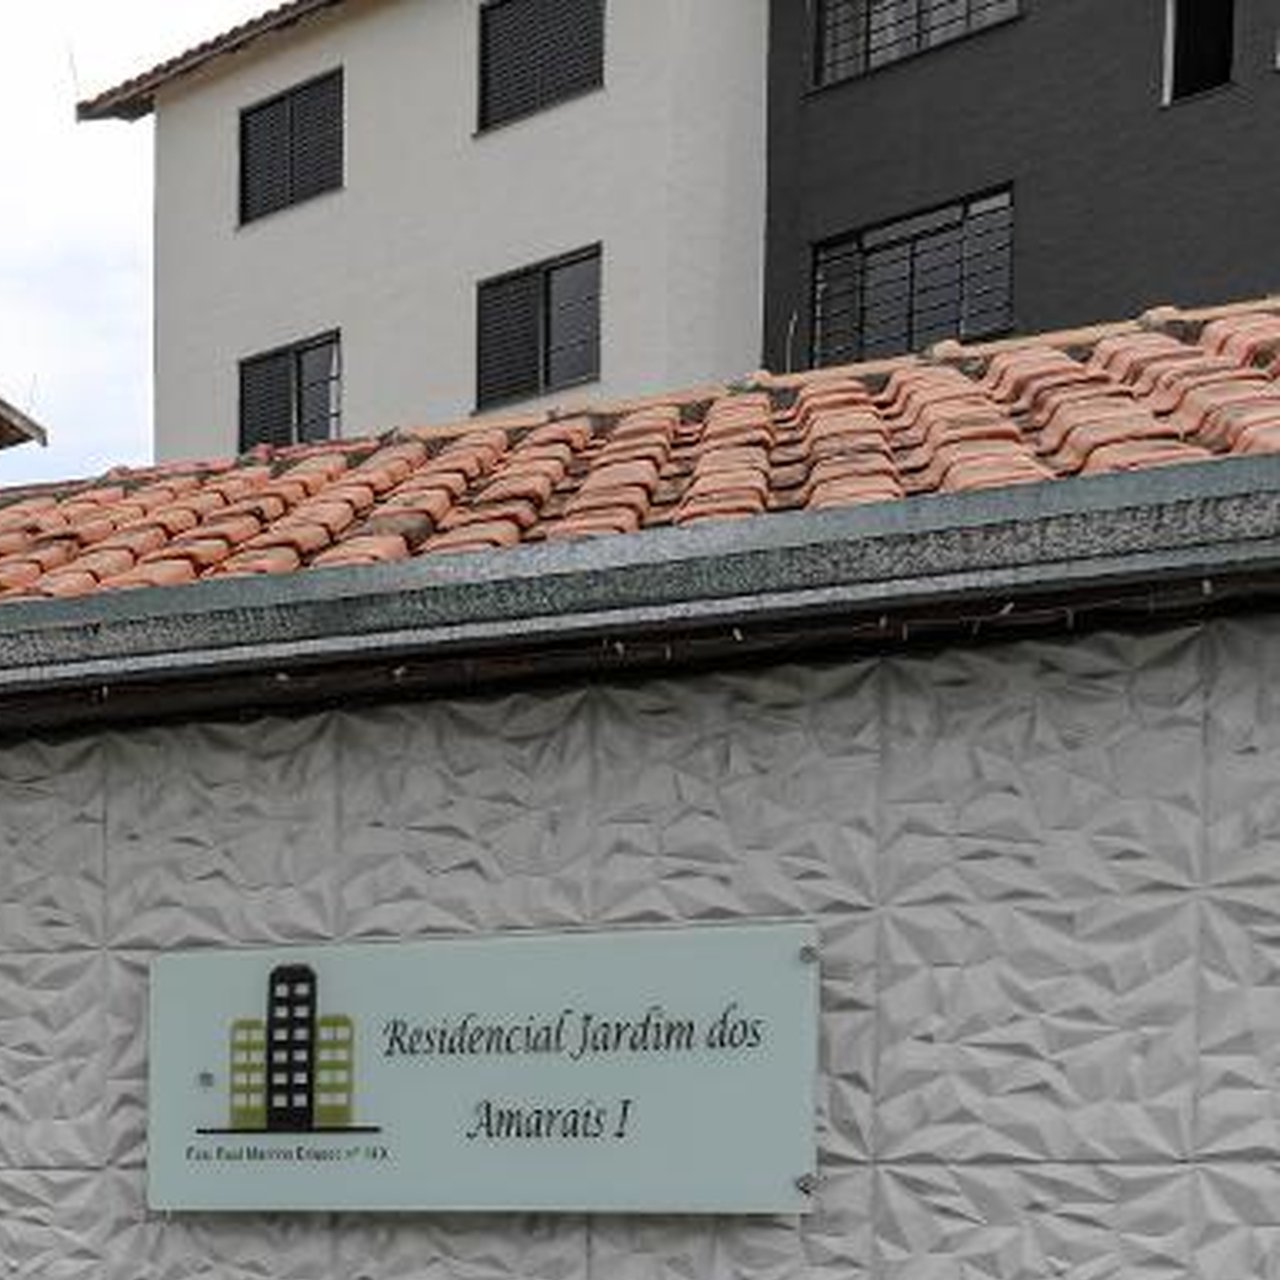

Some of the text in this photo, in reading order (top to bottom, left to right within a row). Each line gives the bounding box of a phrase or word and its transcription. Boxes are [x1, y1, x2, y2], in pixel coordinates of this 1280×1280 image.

[383, 1003, 763, 1061] Residencial Jardim dos
[465, 1099, 606, 1140] Amarais
